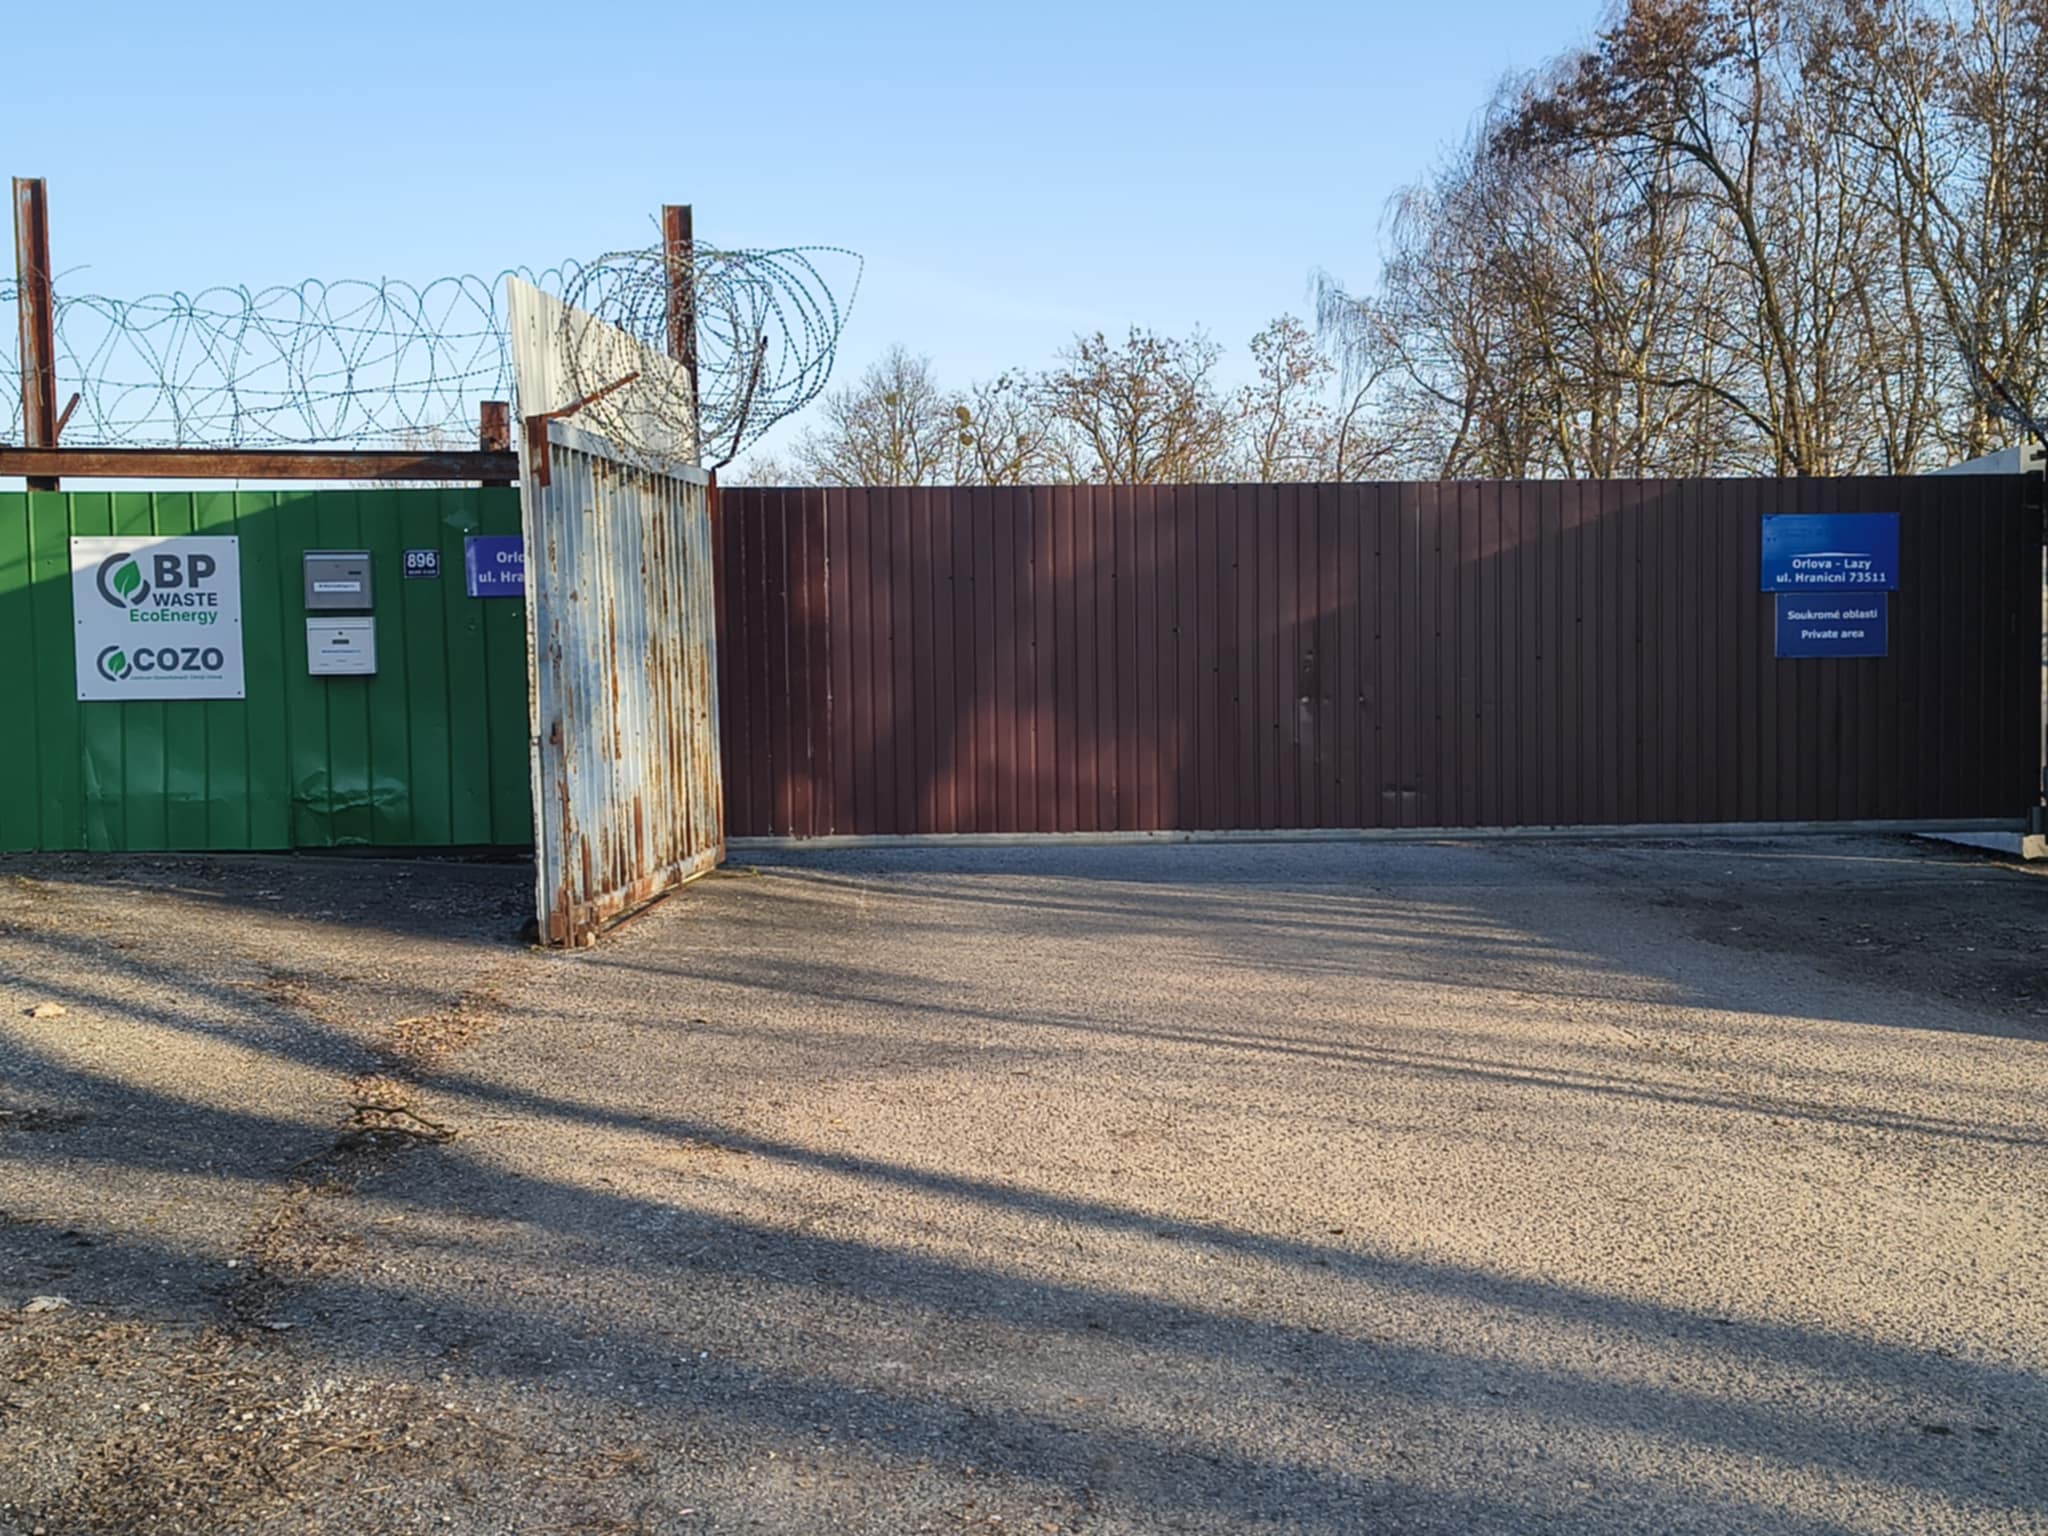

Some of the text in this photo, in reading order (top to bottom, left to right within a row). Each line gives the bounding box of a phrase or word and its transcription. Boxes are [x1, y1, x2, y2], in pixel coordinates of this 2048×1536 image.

[407, 553, 436, 568] 896
[1792, 558, 1832, 569] Orlova
[1844, 558, 1872, 571] Lazy
[153, 554, 216, 589] BP
[478, 571, 497, 583] ul.
[1776, 572, 1792, 583] ul.
[1849, 572, 1886, 583] 73511
[153, 593, 218, 607] WASTE
[130, 609, 218, 625] EcoEnergy
[1801, 629, 1864, 639] Private area
[133, 647, 224, 672] COZO
